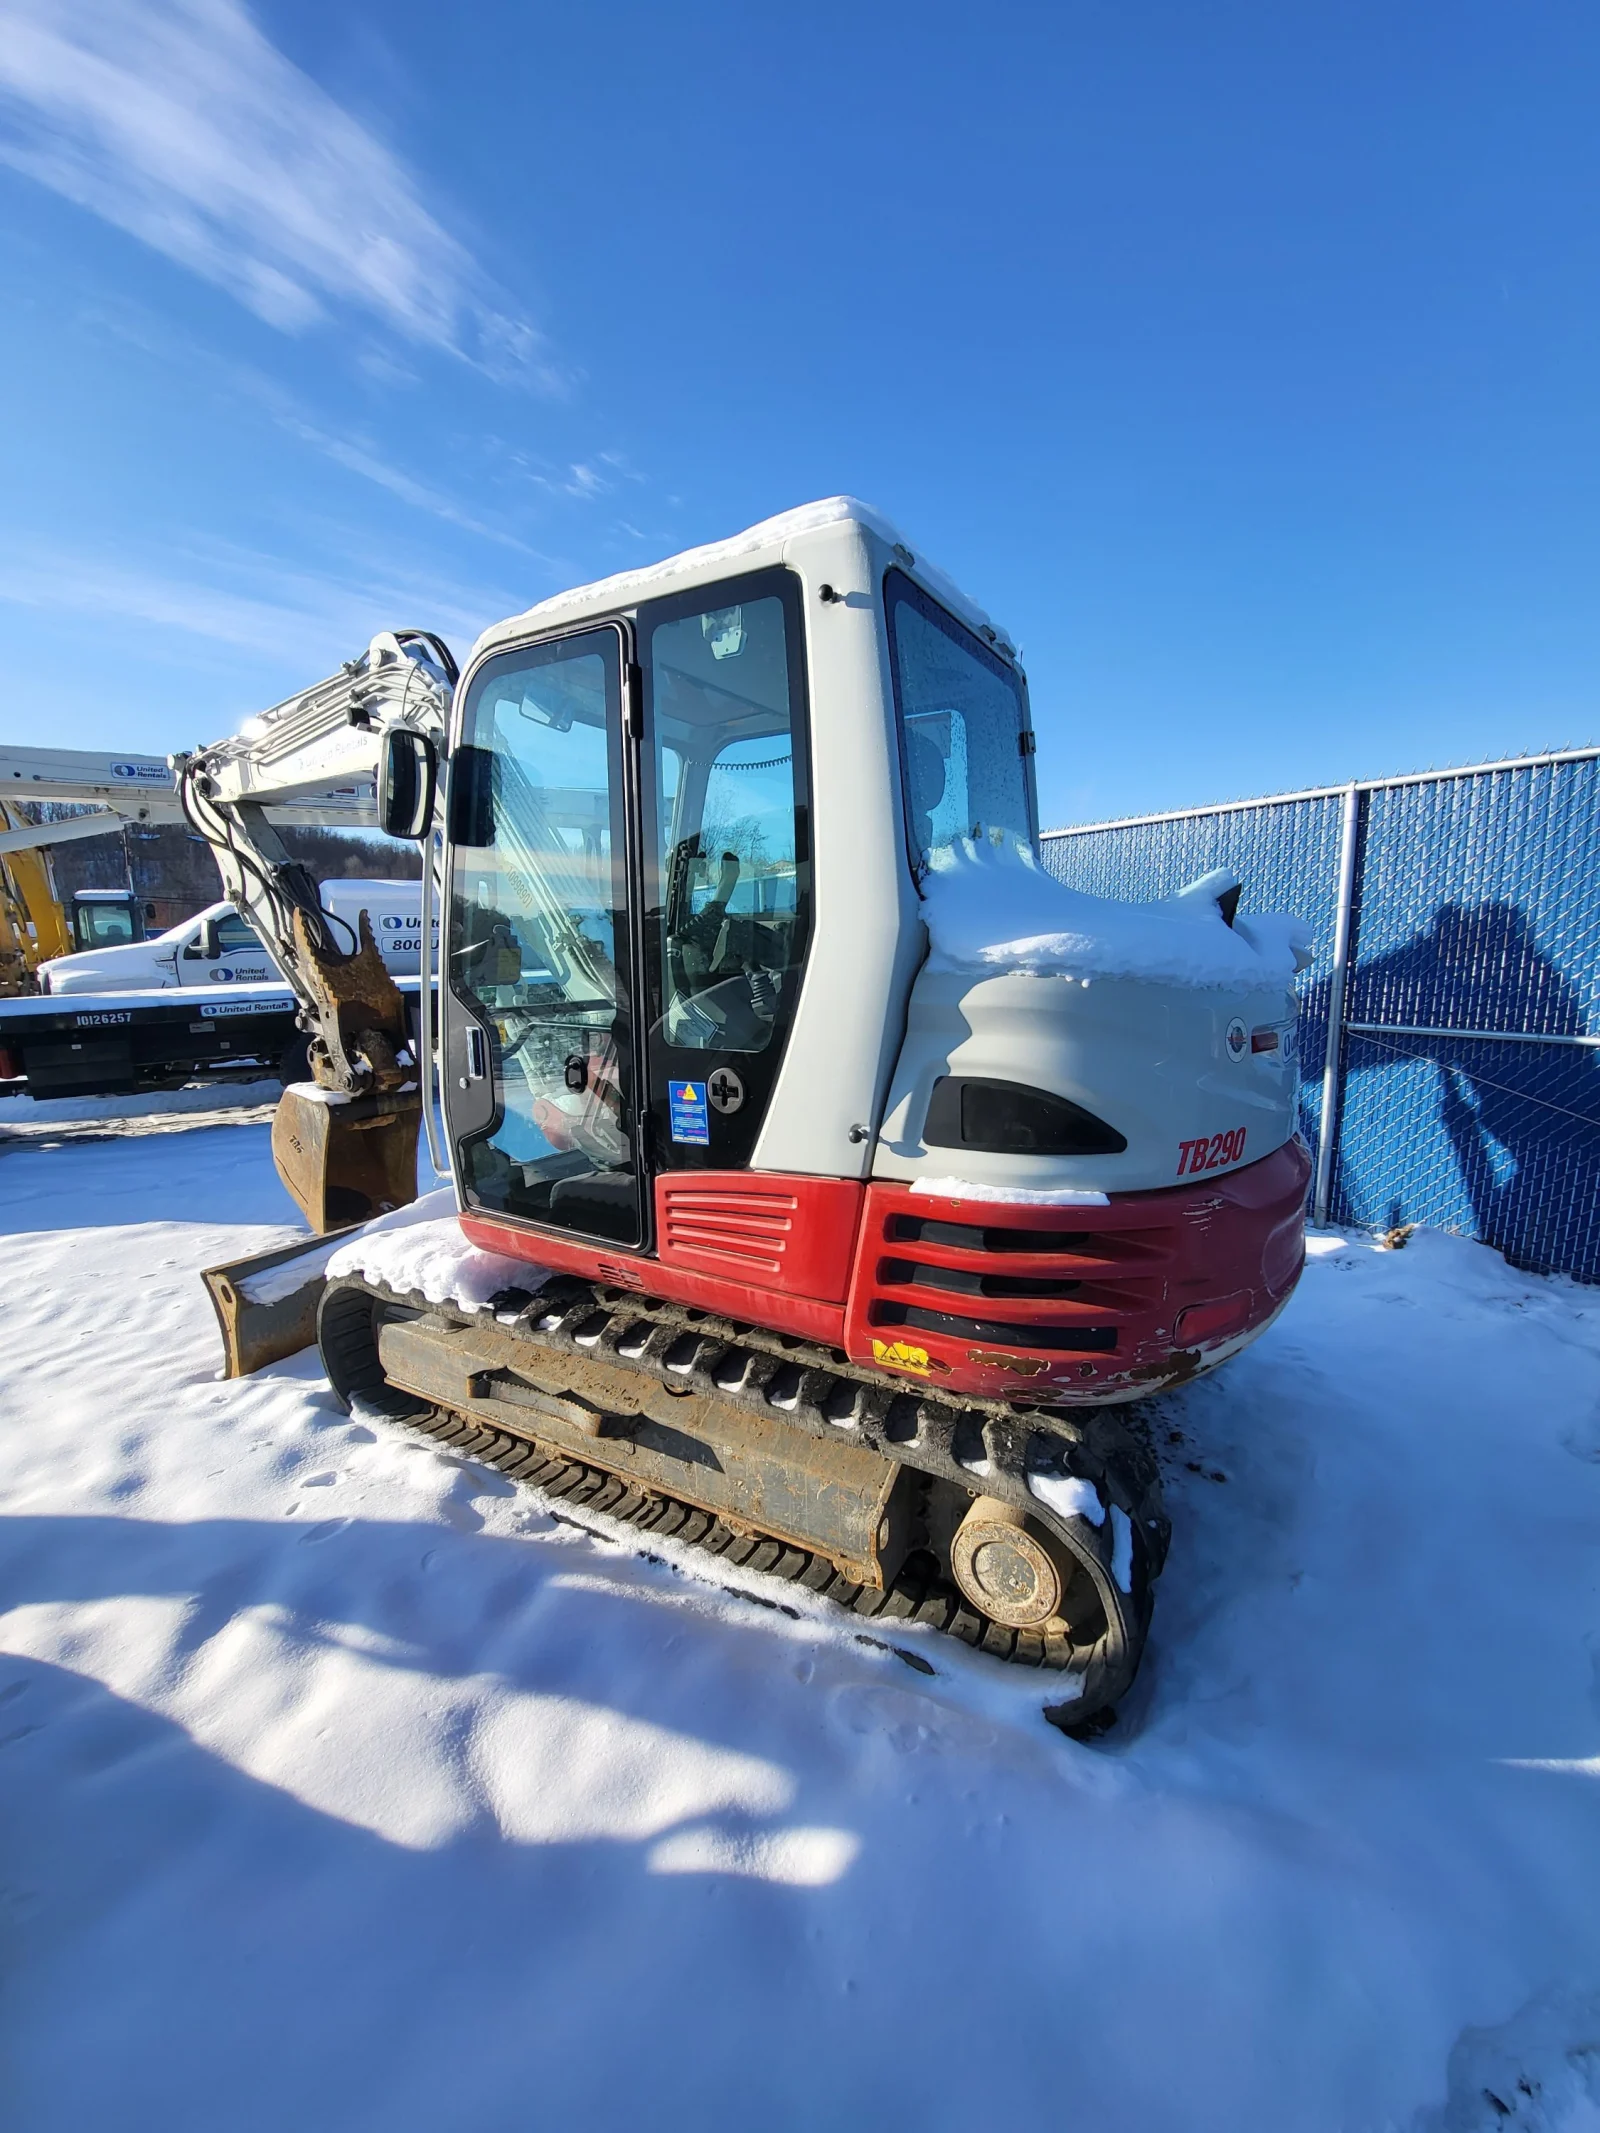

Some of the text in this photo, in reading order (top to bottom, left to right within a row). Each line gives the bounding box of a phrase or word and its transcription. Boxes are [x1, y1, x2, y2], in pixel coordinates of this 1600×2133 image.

[137, 771, 167, 779] Rentals
[235, 967, 266, 975] United
[219, 1002, 289, 1014] United Rentals
[76, 1012, 132, 1026] 10126257
[1176, 1126, 1247, 1176] TB290
